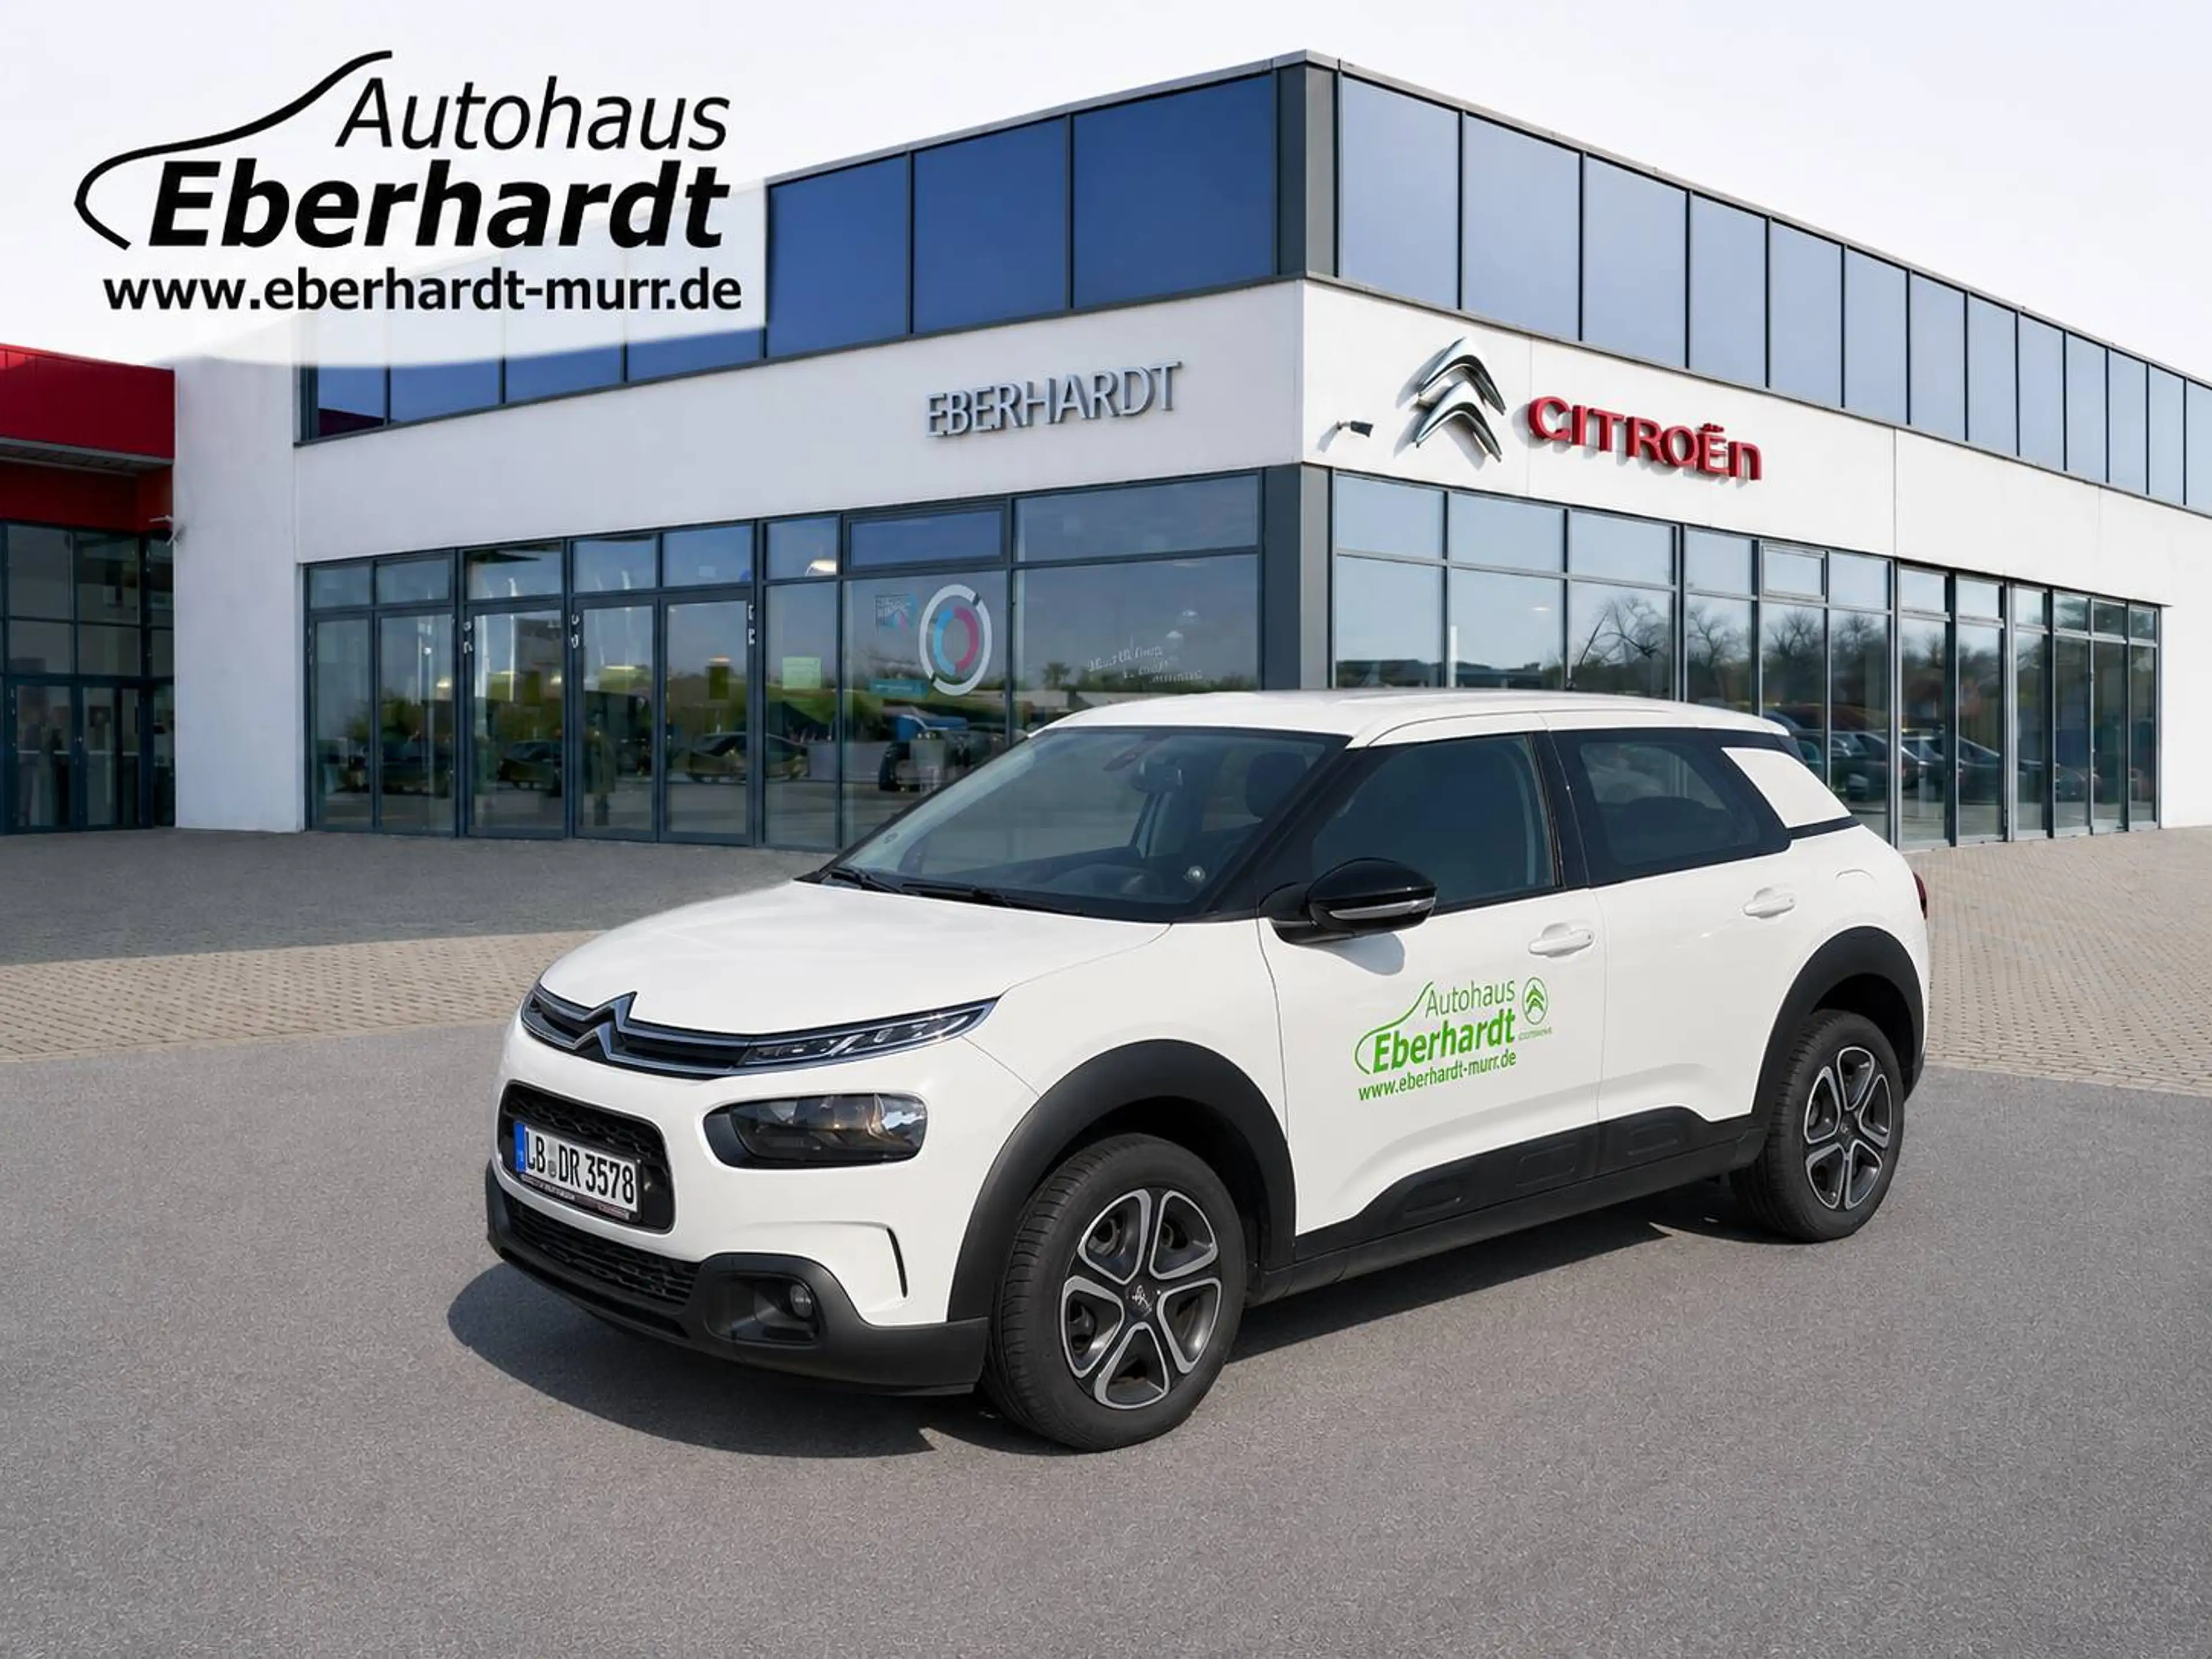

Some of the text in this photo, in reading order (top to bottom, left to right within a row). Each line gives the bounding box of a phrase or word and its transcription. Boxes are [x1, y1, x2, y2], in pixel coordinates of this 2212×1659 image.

[926, 359, 1183, 438] EBERHARDT
[1425, 979, 1516, 1018] Autohaus
[1373, 1008, 1516, 1074] Eberhardt
[1358, 1049, 1517, 1101] www.eberhardt-murr.de
[525, 1131, 546, 1174] LB
[558, 1145, 581, 1188] DR
[585, 1153, 634, 1204] 3578
